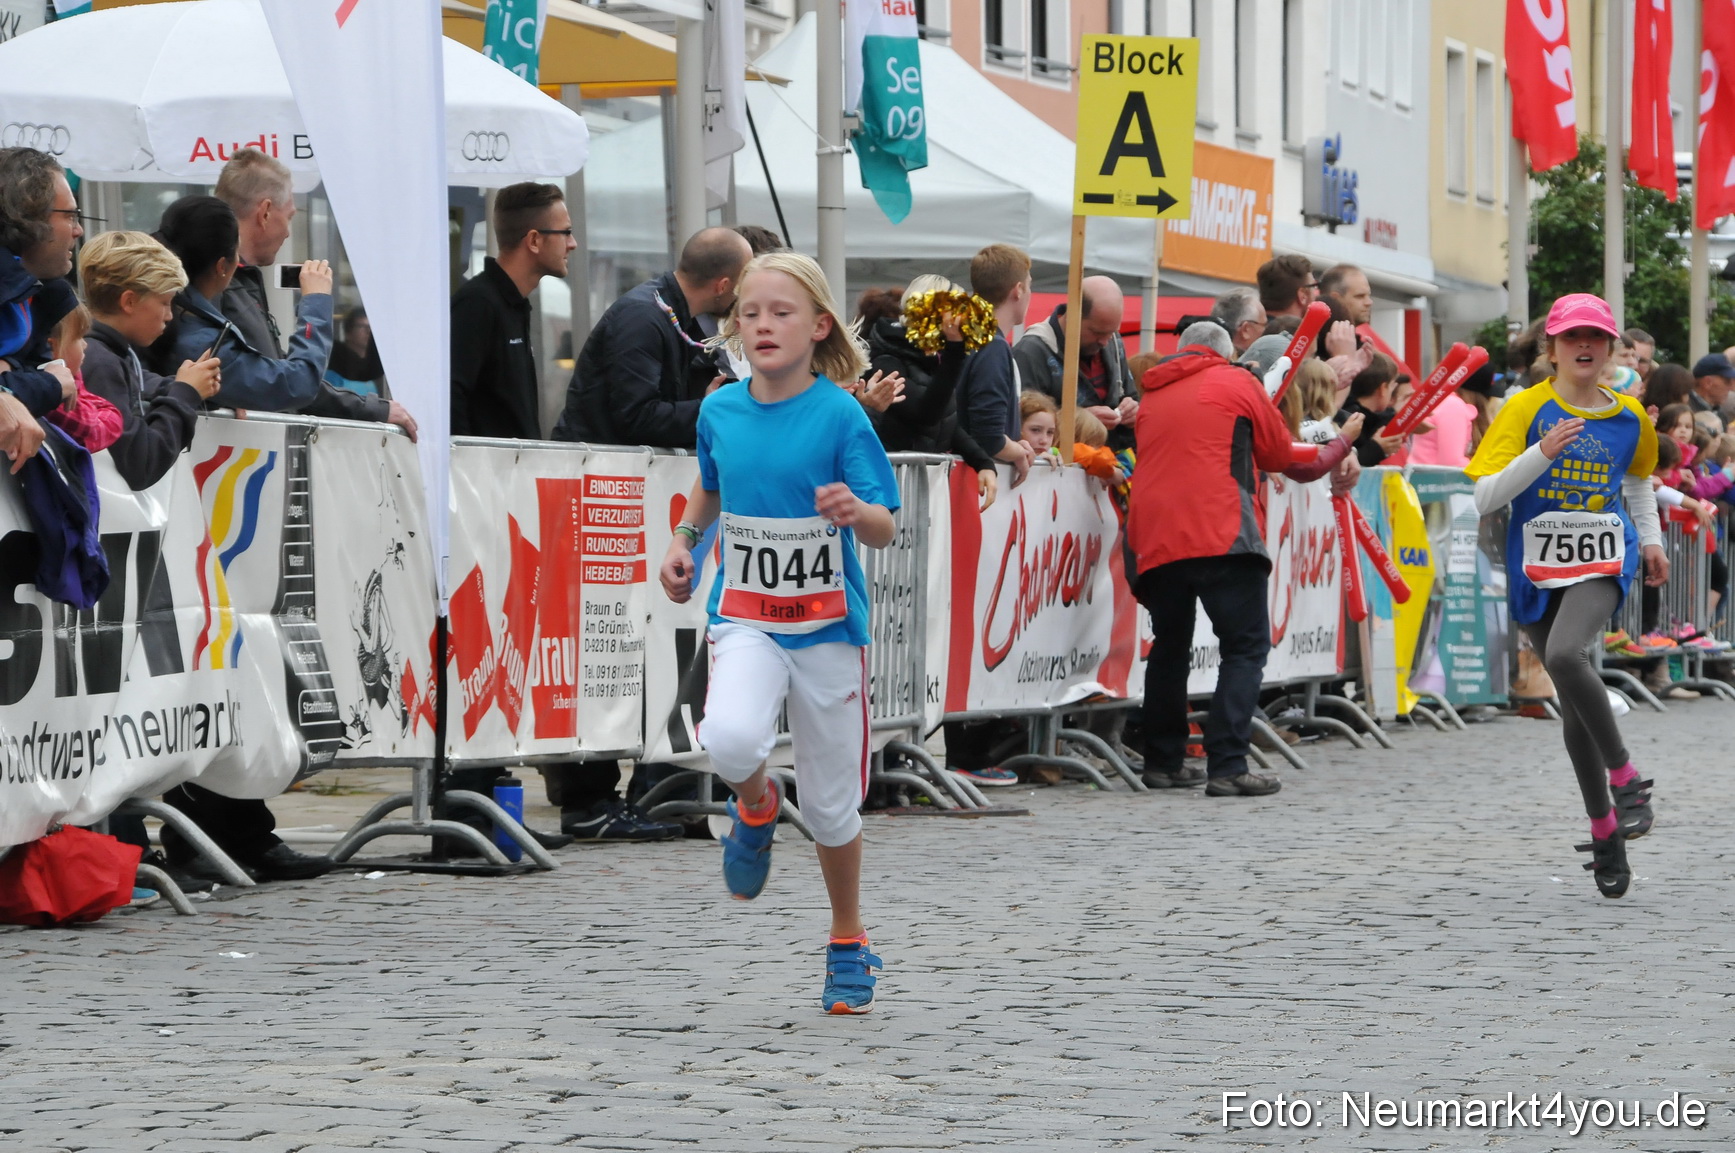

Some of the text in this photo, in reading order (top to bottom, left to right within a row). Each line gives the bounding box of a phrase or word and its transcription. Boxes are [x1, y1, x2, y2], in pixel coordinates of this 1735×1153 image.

[1093, 42, 1184, 76] Block
[1098, 90, 1167, 178] A
[725, 523, 822, 541] PARTL Neumarkt
[1526, 519, 1607, 530] PARTL Neumarkt
[1535, 531, 1616, 563] 7560
[733, 543, 834, 590] 7044
[585, 601, 610, 616] Braun
[760, 600, 806, 618] Larah
